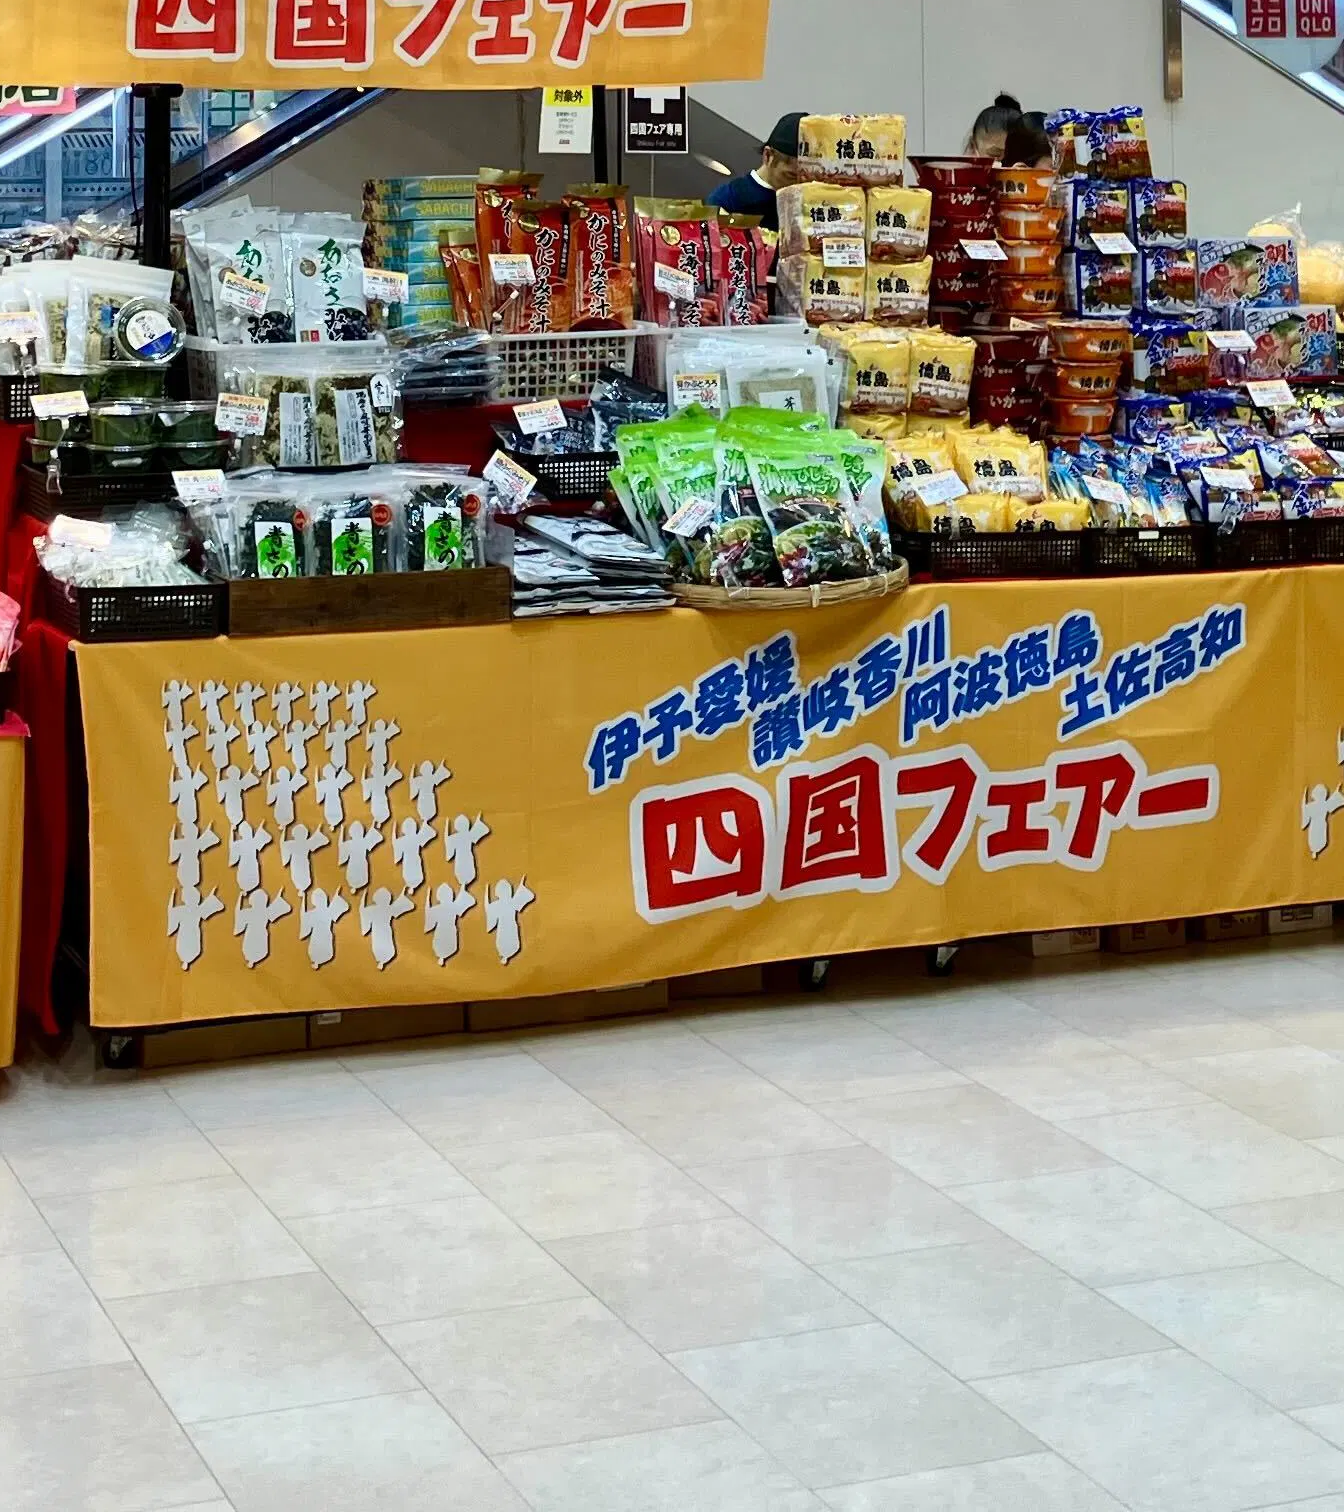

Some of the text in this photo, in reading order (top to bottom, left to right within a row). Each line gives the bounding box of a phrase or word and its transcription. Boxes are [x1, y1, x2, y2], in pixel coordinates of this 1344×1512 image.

[1299, 16, 1333, 33] QLO
[553, 89, 584, 104] 対象外
[629, 122, 683, 137] 四国フェア専用
[835, 138, 876, 160] 徳島
[586, 212, 611, 320] かにのみそ汁
[529, 228, 559, 334] かにのみそ汁
[855, 370, 889, 388] 徳島
[918, 361, 952, 382] 徳島
[588, 605, 1245, 788] 伊予愛媛 讃岐香川 阿波徳島 土佐高知
[643, 754, 1211, 913] 四国フェアー
